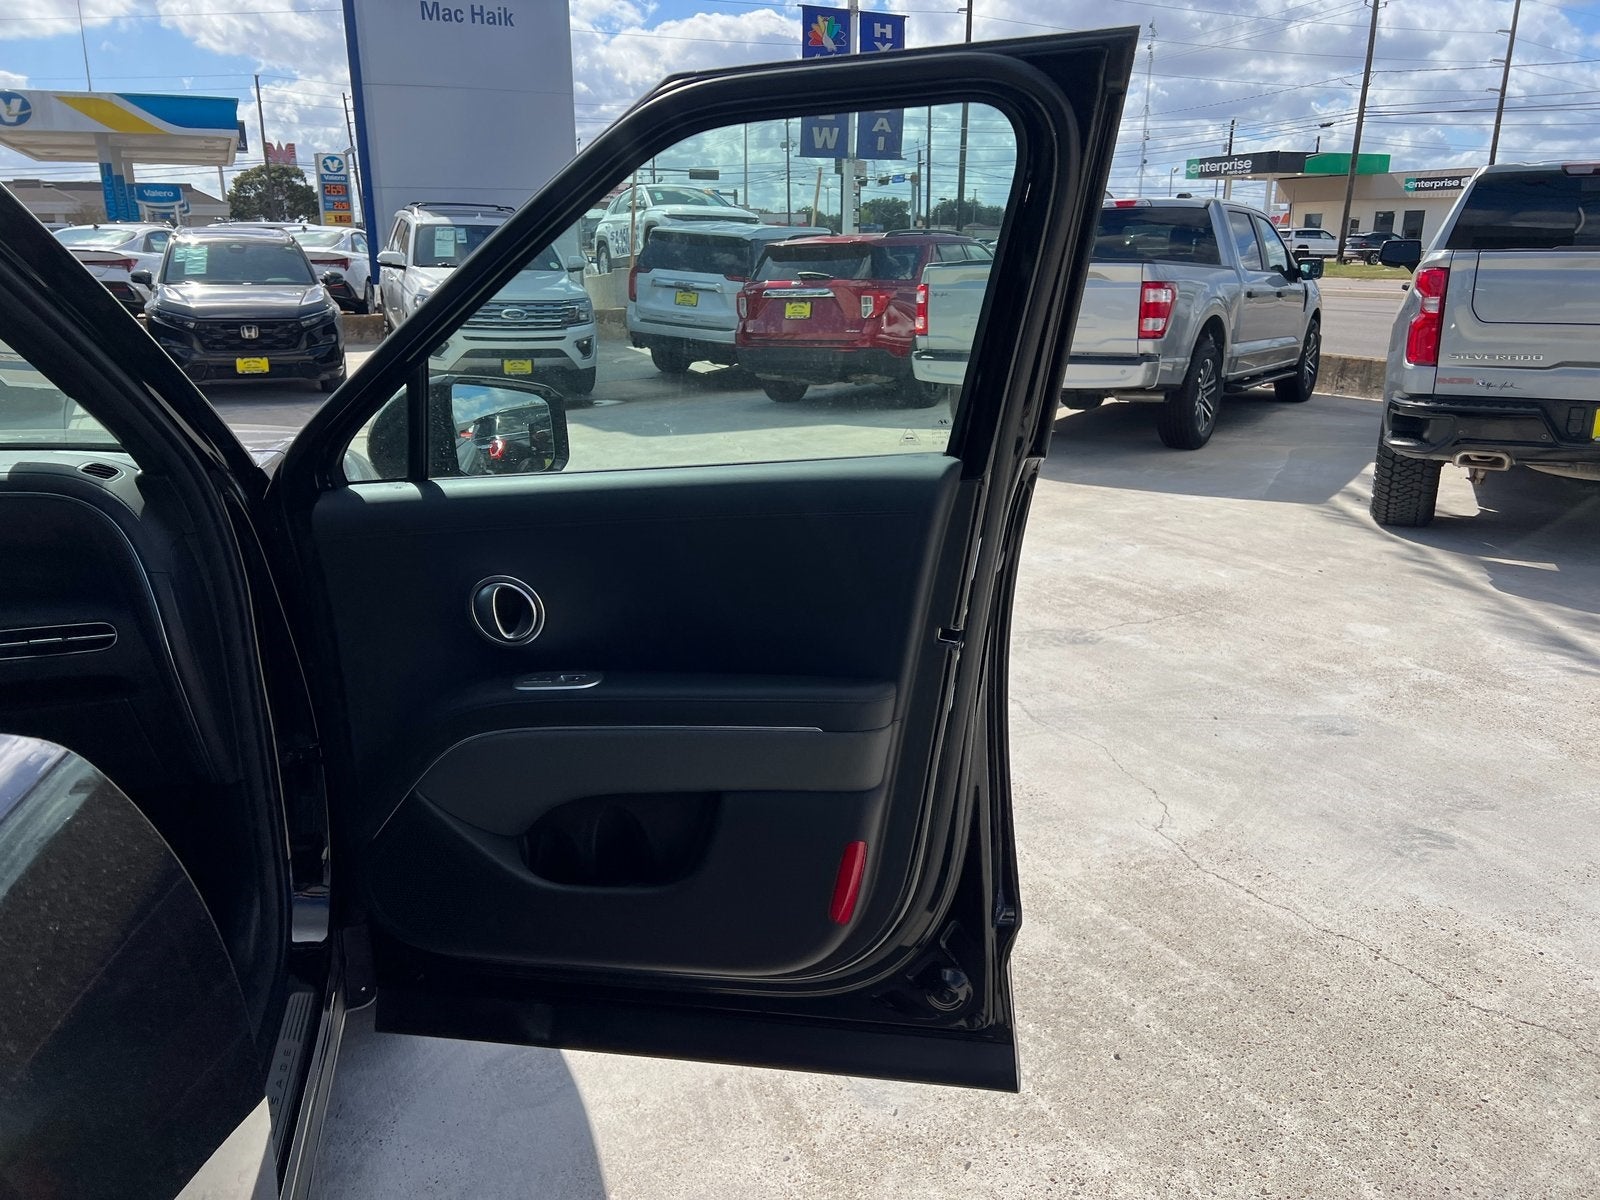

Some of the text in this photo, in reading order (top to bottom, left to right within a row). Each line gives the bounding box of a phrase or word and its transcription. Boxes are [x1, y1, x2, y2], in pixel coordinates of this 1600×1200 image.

[420, 1, 515, 27] Mac Haik
[1186, 158, 1253, 174] enterprise
[1405, 178, 1460, 189] enterprise
[143, 189, 174, 197] Valero
[1447, 352, 1544, 361] SILVERADO
